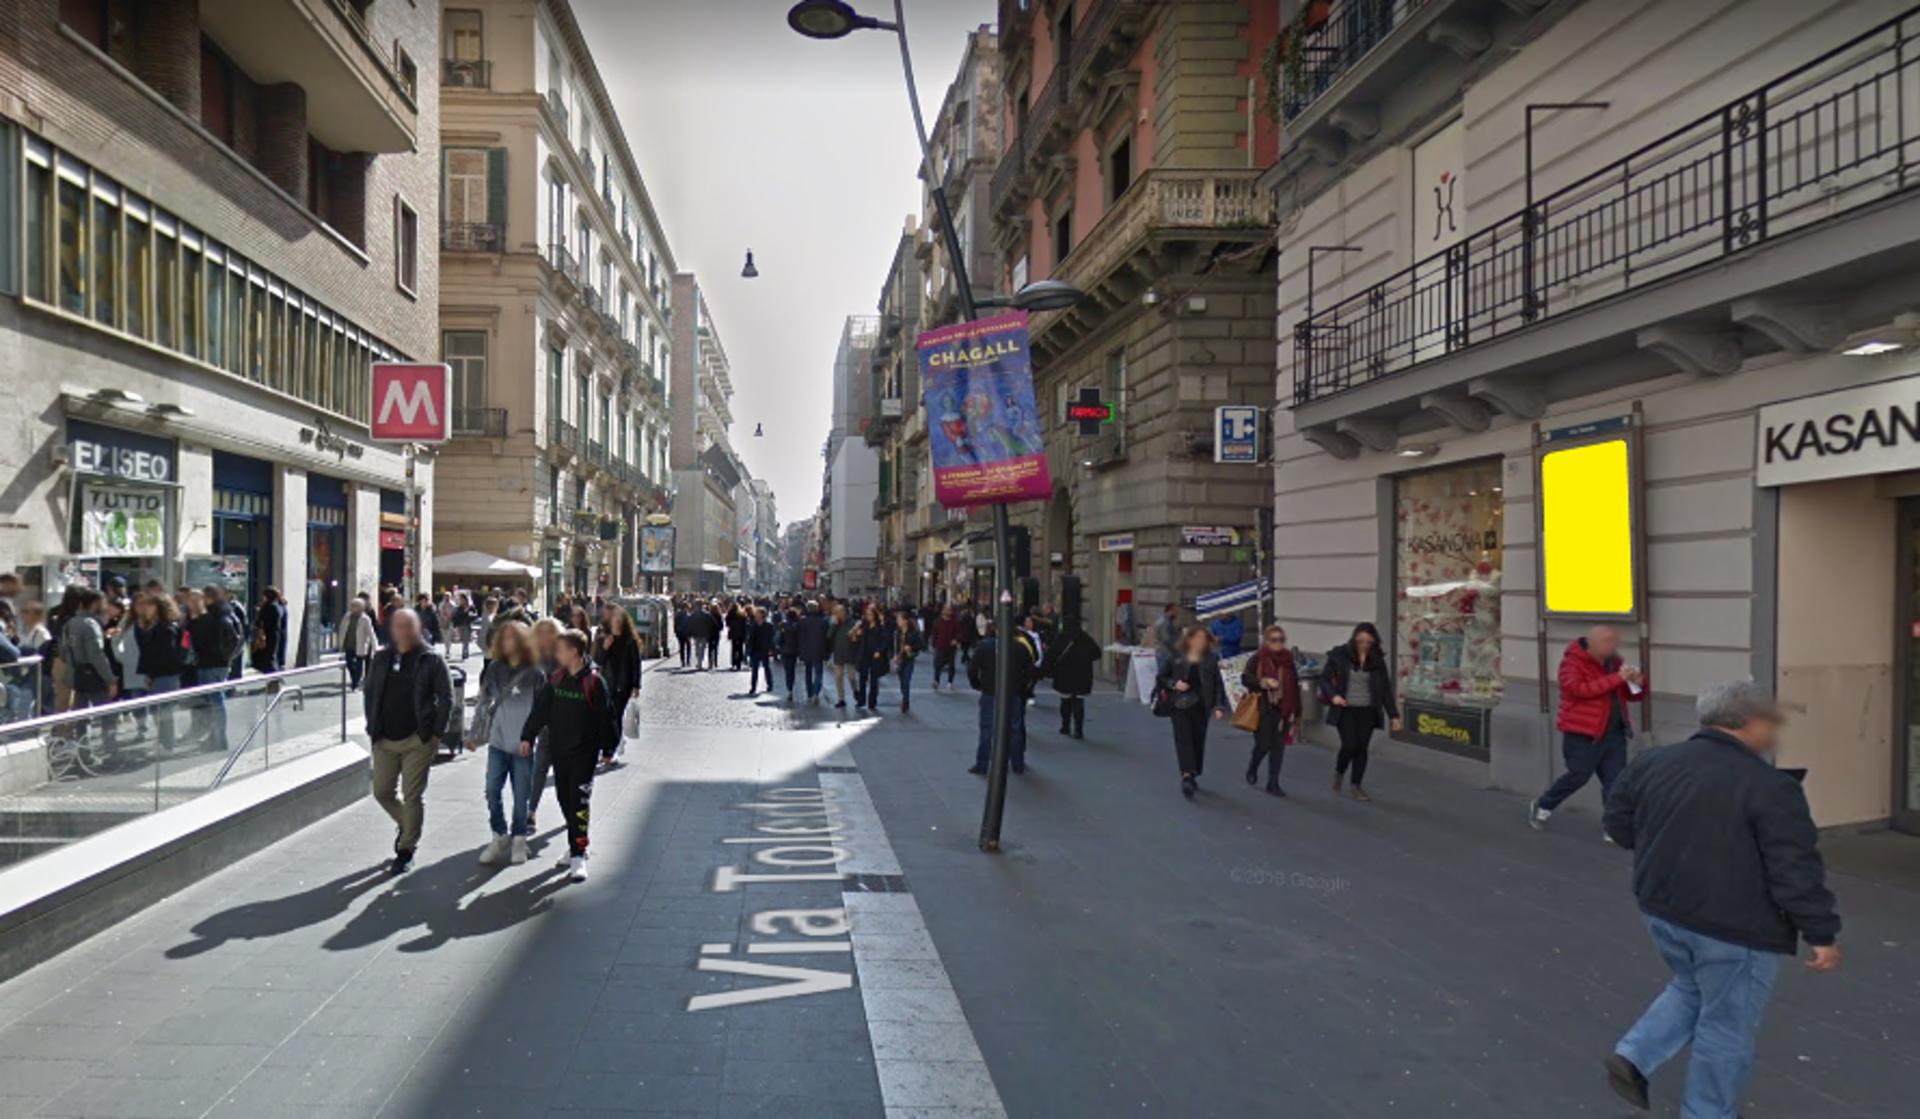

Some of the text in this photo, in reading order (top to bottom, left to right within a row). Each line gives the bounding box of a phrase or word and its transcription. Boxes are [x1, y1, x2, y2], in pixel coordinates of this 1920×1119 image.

[929, 340, 1020, 367] CHAGALL
[378, 380, 439, 425] M
[75, 440, 168, 480] ELISEO
[89, 489, 160, 511] TUTTO
[687, 787, 852, 1011] Via Toledo
